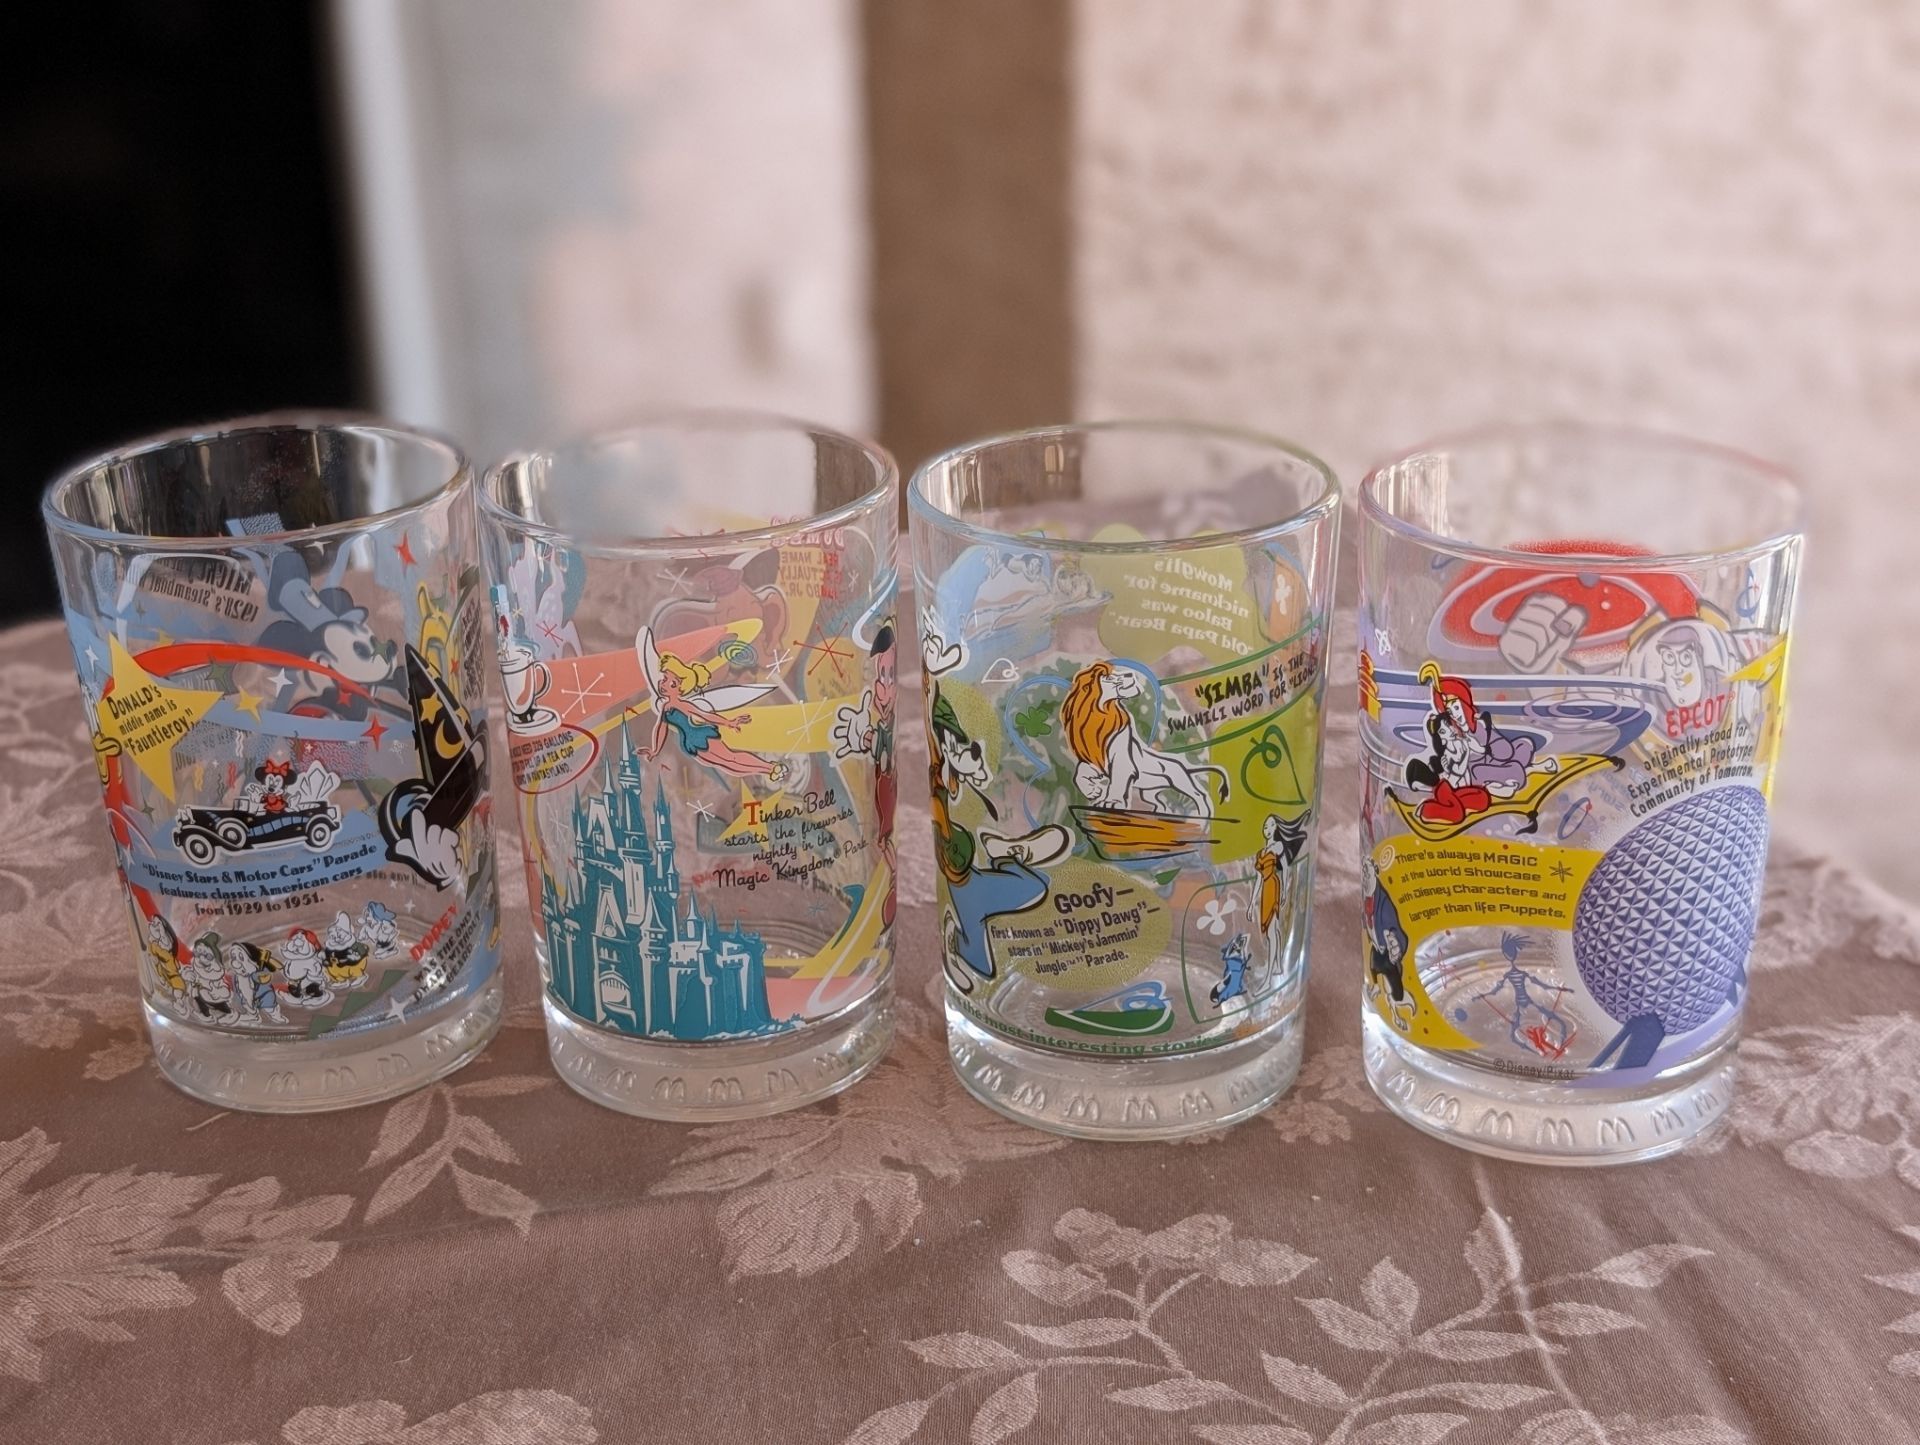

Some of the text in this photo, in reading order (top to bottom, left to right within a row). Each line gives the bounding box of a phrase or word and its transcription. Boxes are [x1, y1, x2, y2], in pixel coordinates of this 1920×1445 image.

[1194, 652, 1305, 709] "SIMBA" IS THE
[106, 684, 162, 720] DONALD's
[118, 698, 178, 736] middle name is
[1167, 706, 1227, 735] SWAHILI
[1231, 692, 1264, 717] WORD
[1269, 682, 1287, 704] FOR
[543, 730, 574, 749] GALLONS
[547, 751, 560, 764] TEA
[560, 745, 575, 759] CUP
[1643, 723, 1748, 771] originally stood for
[1627, 750, 1707, 799] Experimental
[1710, 743, 1753, 764] Prototype
[743, 789, 836, 826] Tinker Bell
[1629, 775, 1695, 818] Community
[1699, 769, 1711, 785] of
[1714, 765, 1754, 780] Tomorrow.
[724, 807, 854, 847] starts the fireworks
[142, 844, 378, 884] "Disney Stars & Motor Cars" Parade
[712, 868, 770, 891] Magic
[843, 838, 869, 858] Park
[753, 832, 836, 866] nightly in the
[1395, 849, 1538, 867] There's always MAGIC
[159, 882, 208, 899] features
[210, 886, 257, 900] classic
[259, 878, 330, 897] American
[332, 866, 363, 881] cars
[1400, 866, 1541, 884] at the World Showcase
[1413, 886, 1451, 898] Disney
[1452, 884, 1539, 898] Characters
[1542, 891, 1566, 901] and
[195, 892, 324, 916] from 1929 to 1951.
[1409, 902, 1566, 922] larger than life Puppets.
[410, 901, 457, 962] DOPEY
[990, 924, 1011, 939] first
[1011, 926, 1042, 939] known
[1043, 926, 1055, 937] as
[1053, 917, 1101, 937] "Dippy
[1008, 925, 1140, 957] stars in "Mickey's Jammin'
[436, 935, 455, 960] THE
[1085, 949, 1129, 967] Parade.
[962, 998, 986, 1021] the
[984, 1014, 1025, 1038] most
[1029, 1029, 1146, 1056] interesting
